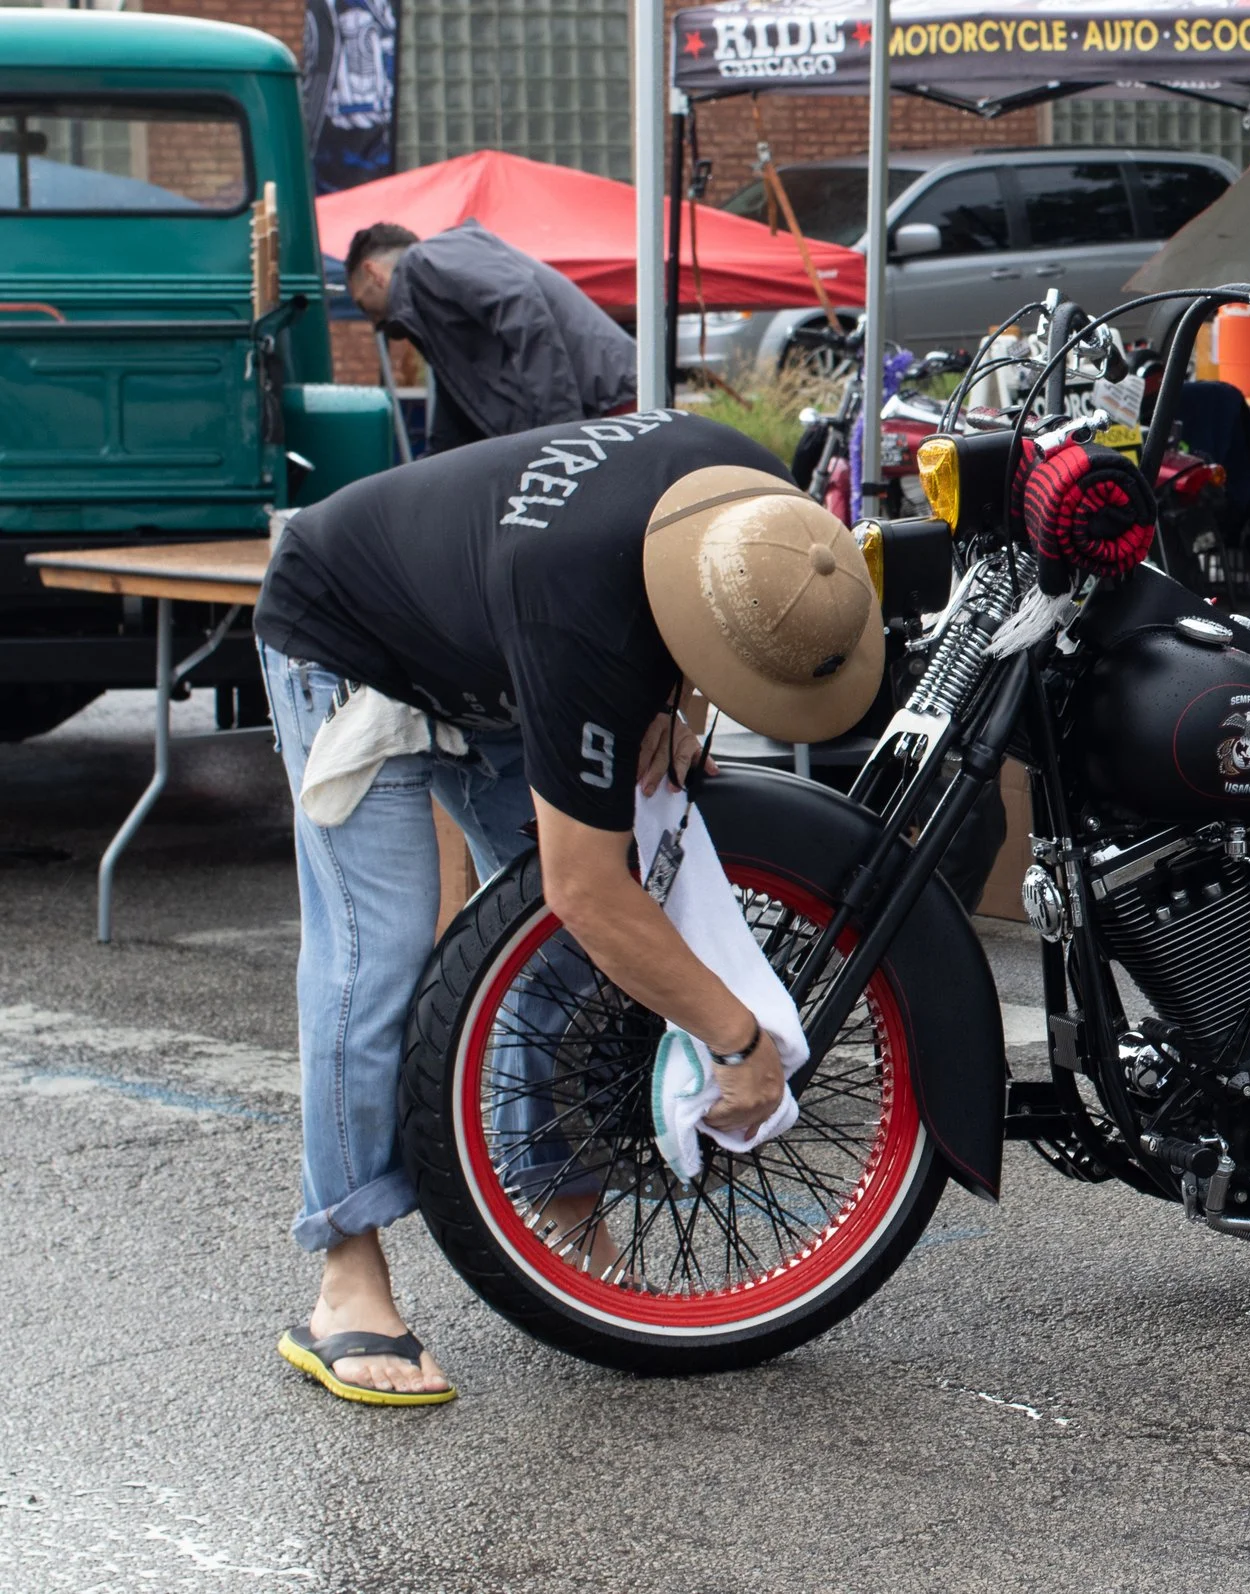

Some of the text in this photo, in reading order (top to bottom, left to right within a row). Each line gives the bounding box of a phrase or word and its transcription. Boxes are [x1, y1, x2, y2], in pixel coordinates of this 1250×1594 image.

[712, 15, 848, 60] RIDE
[1083, 19, 1159, 51] AUTO
[718, 54, 836, 79] CHICAGO
[580, 721, 616, 789] 9
